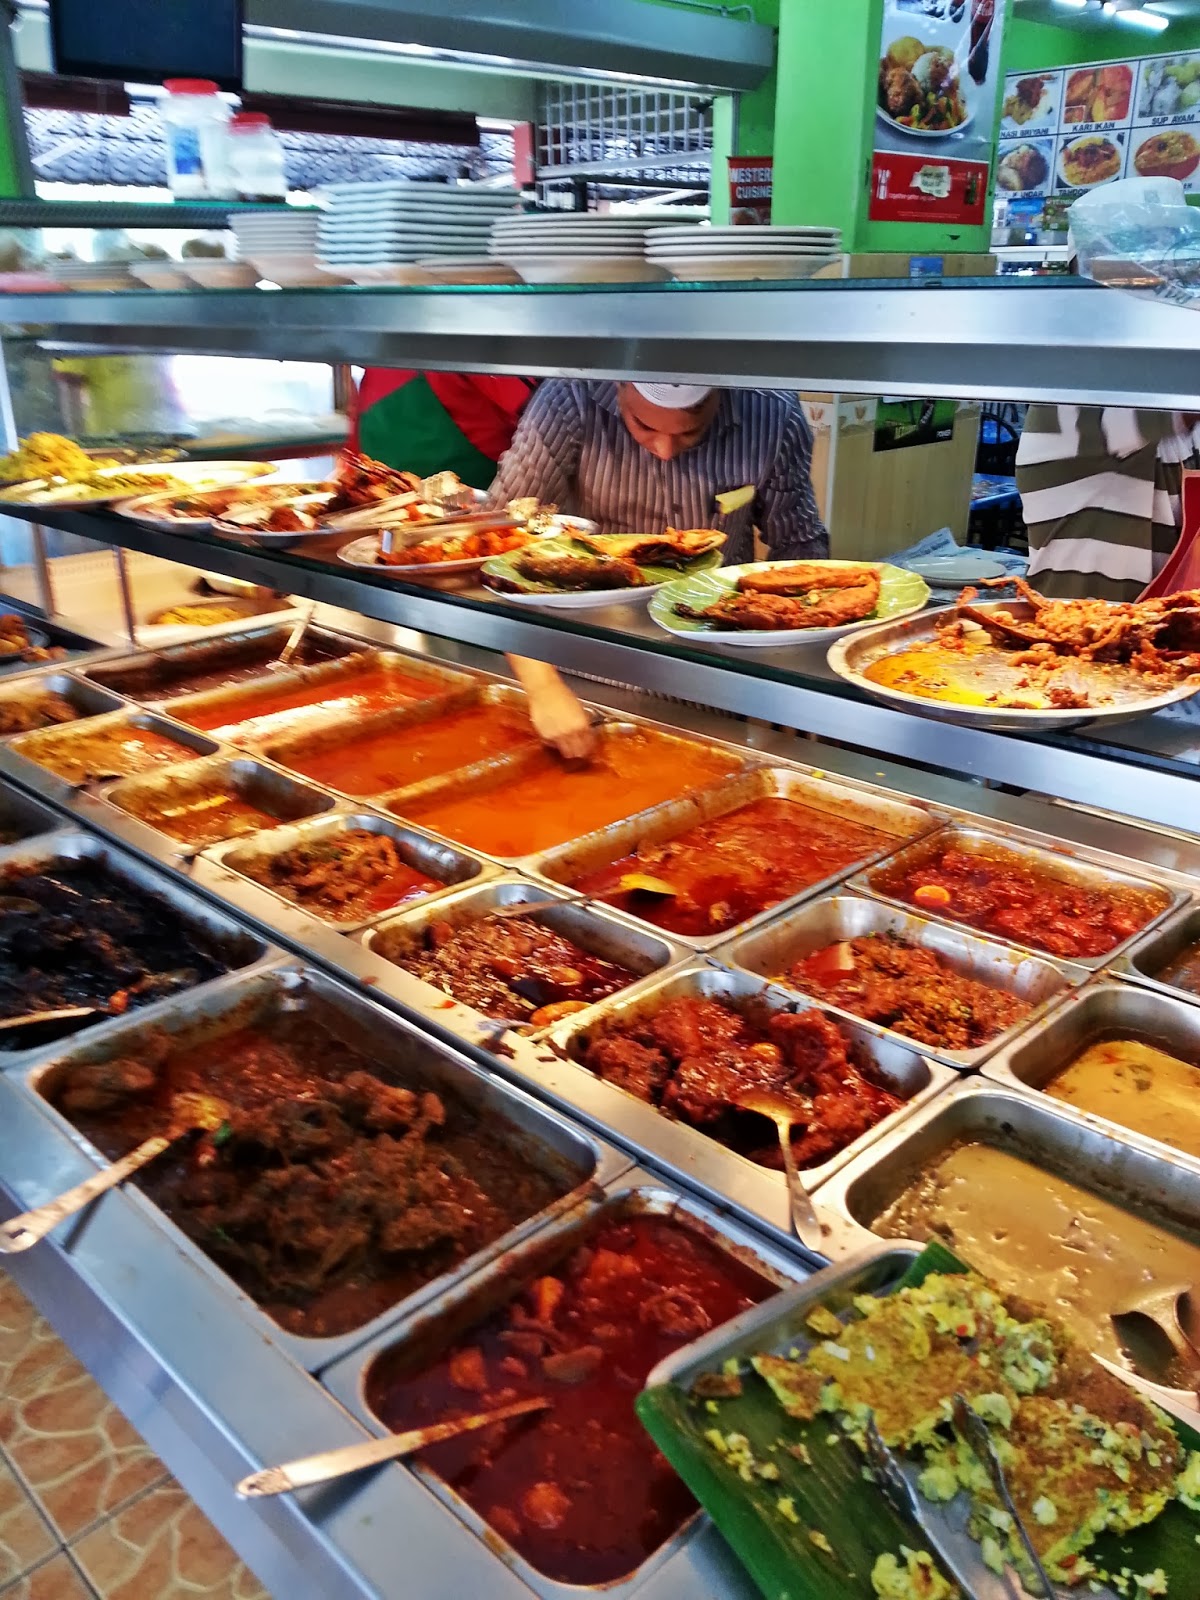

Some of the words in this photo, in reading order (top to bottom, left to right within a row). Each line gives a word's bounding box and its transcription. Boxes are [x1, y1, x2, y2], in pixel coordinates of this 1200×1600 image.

[1152, 116, 1169, 125] SUP
[1171, 114, 1195, 124] AYAM
[1072, 123, 1093, 132] KARI
[1094, 122, 1115, 130] IKAN
[736, 185, 773, 199] CUISINE
